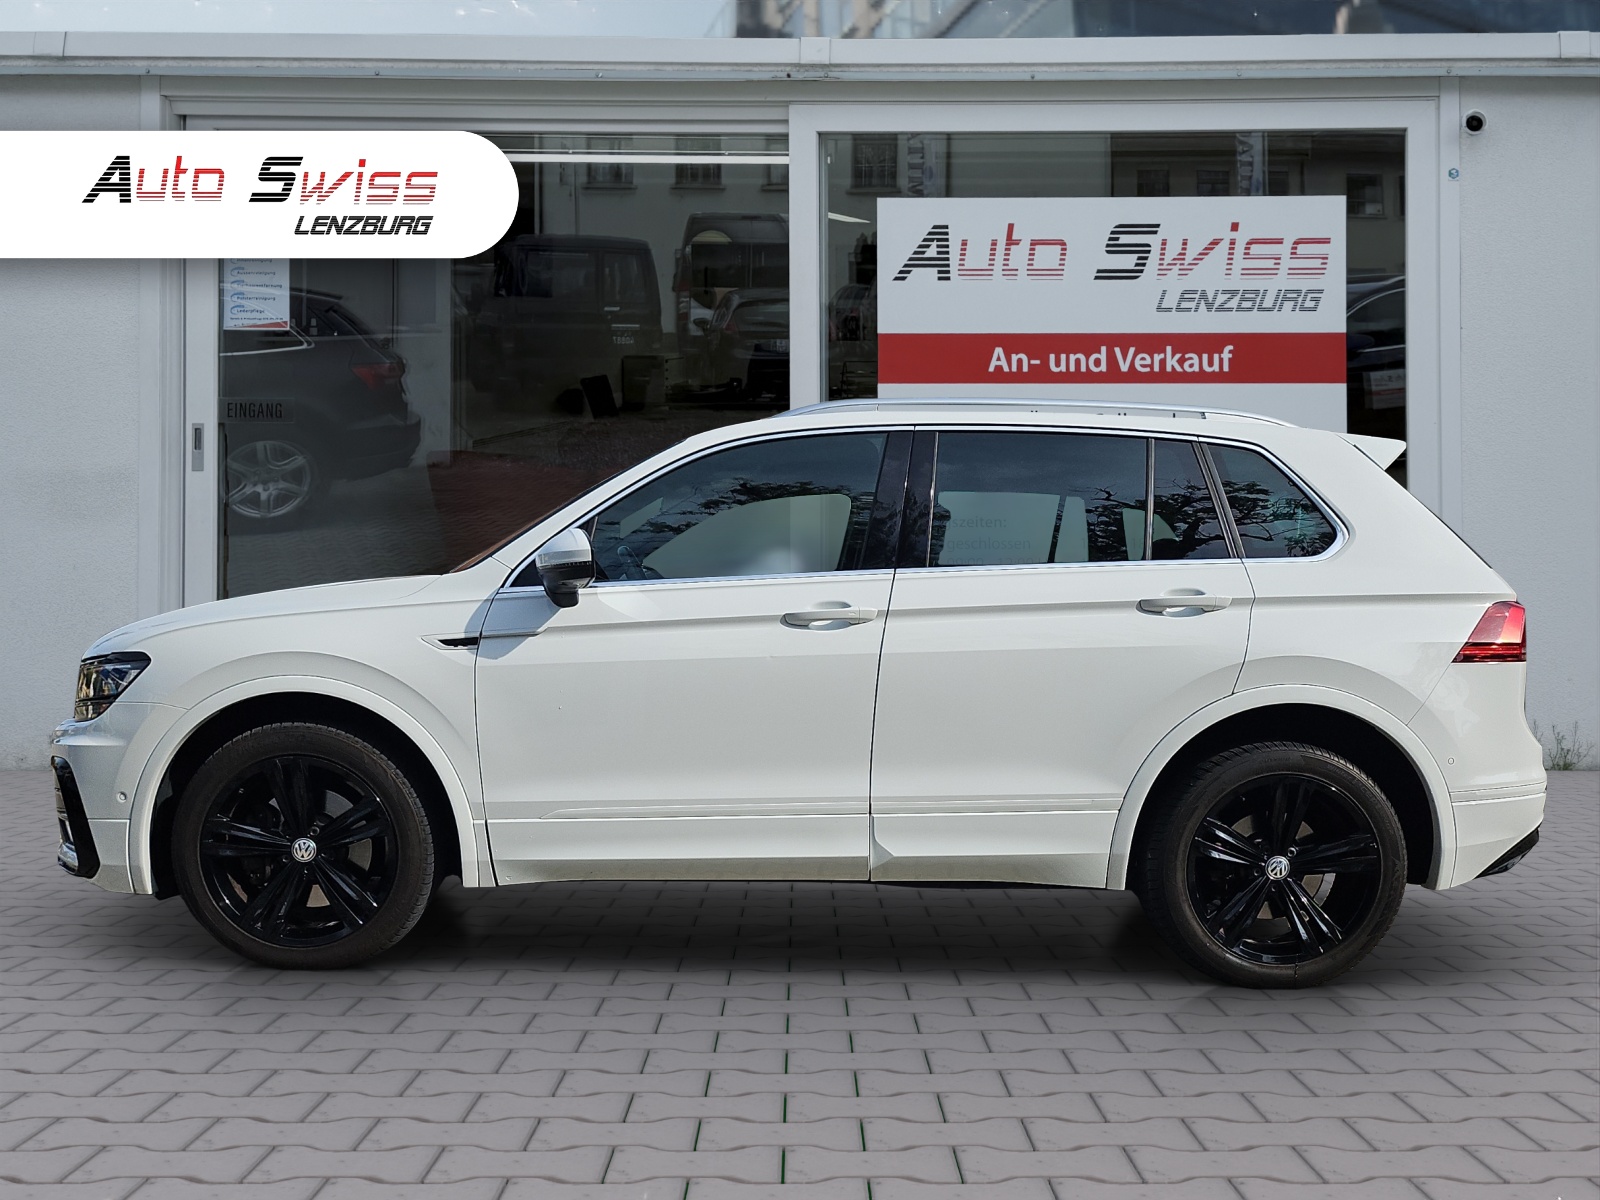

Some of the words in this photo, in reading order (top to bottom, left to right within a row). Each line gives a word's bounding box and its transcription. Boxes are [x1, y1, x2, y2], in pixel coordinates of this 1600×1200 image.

[892, 223, 1068, 281] Auto
[1094, 222, 1331, 281] Swiss
[1155, 289, 1325, 313] LENZBURG
[988, 346, 1042, 373] An-
[1049, 345, 1108, 374] und
[1114, 345, 1234, 374] Verkauf
[226, 402, 283, 419] EINGANG
